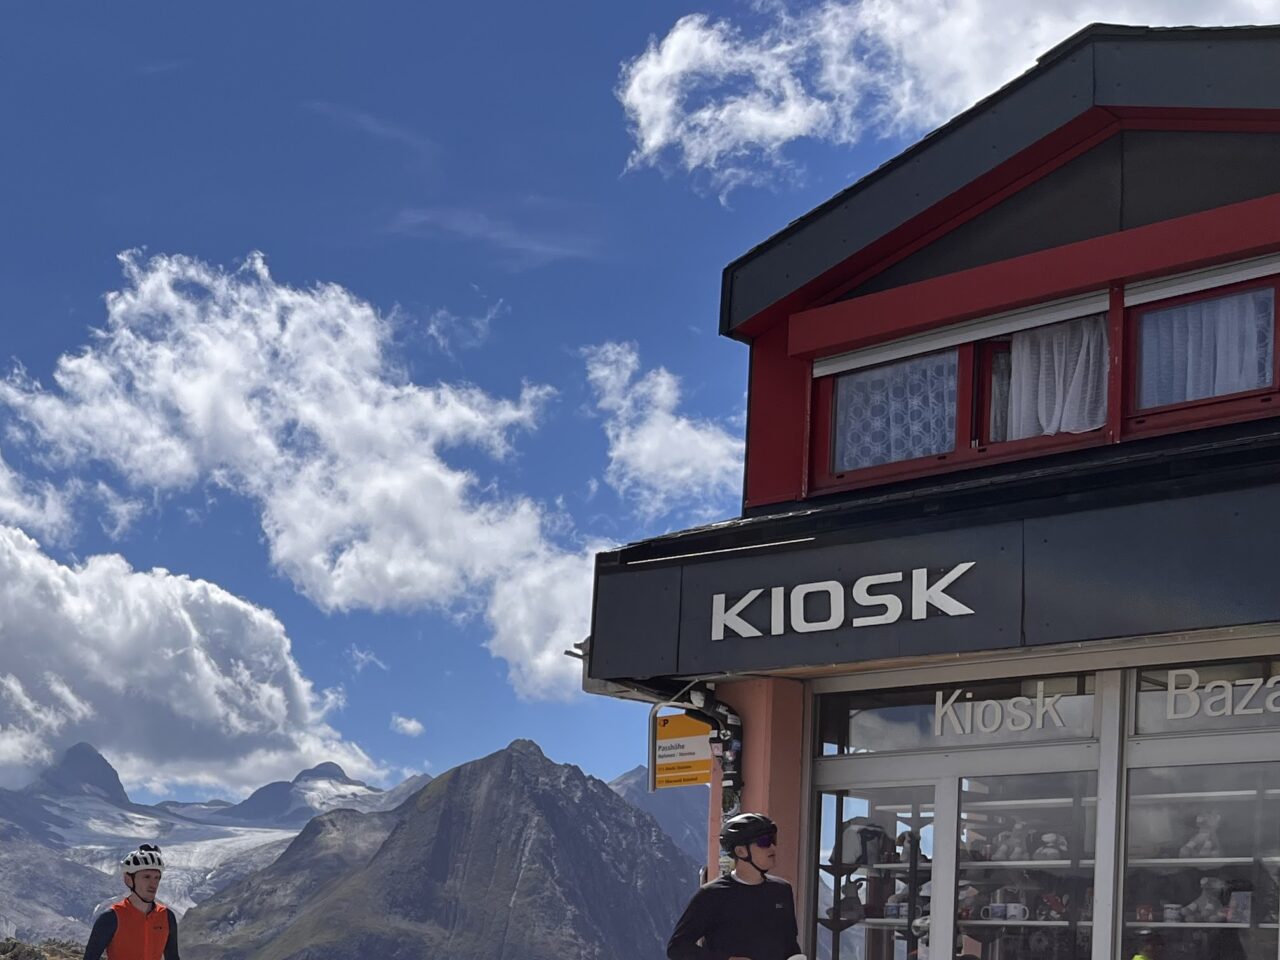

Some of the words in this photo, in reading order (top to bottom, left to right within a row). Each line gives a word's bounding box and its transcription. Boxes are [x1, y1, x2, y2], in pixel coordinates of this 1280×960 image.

[711, 561, 977, 641] KIOSK
[934, 681, 1068, 737] Kiosk
[1166, 668, 1280, 721] Baza
